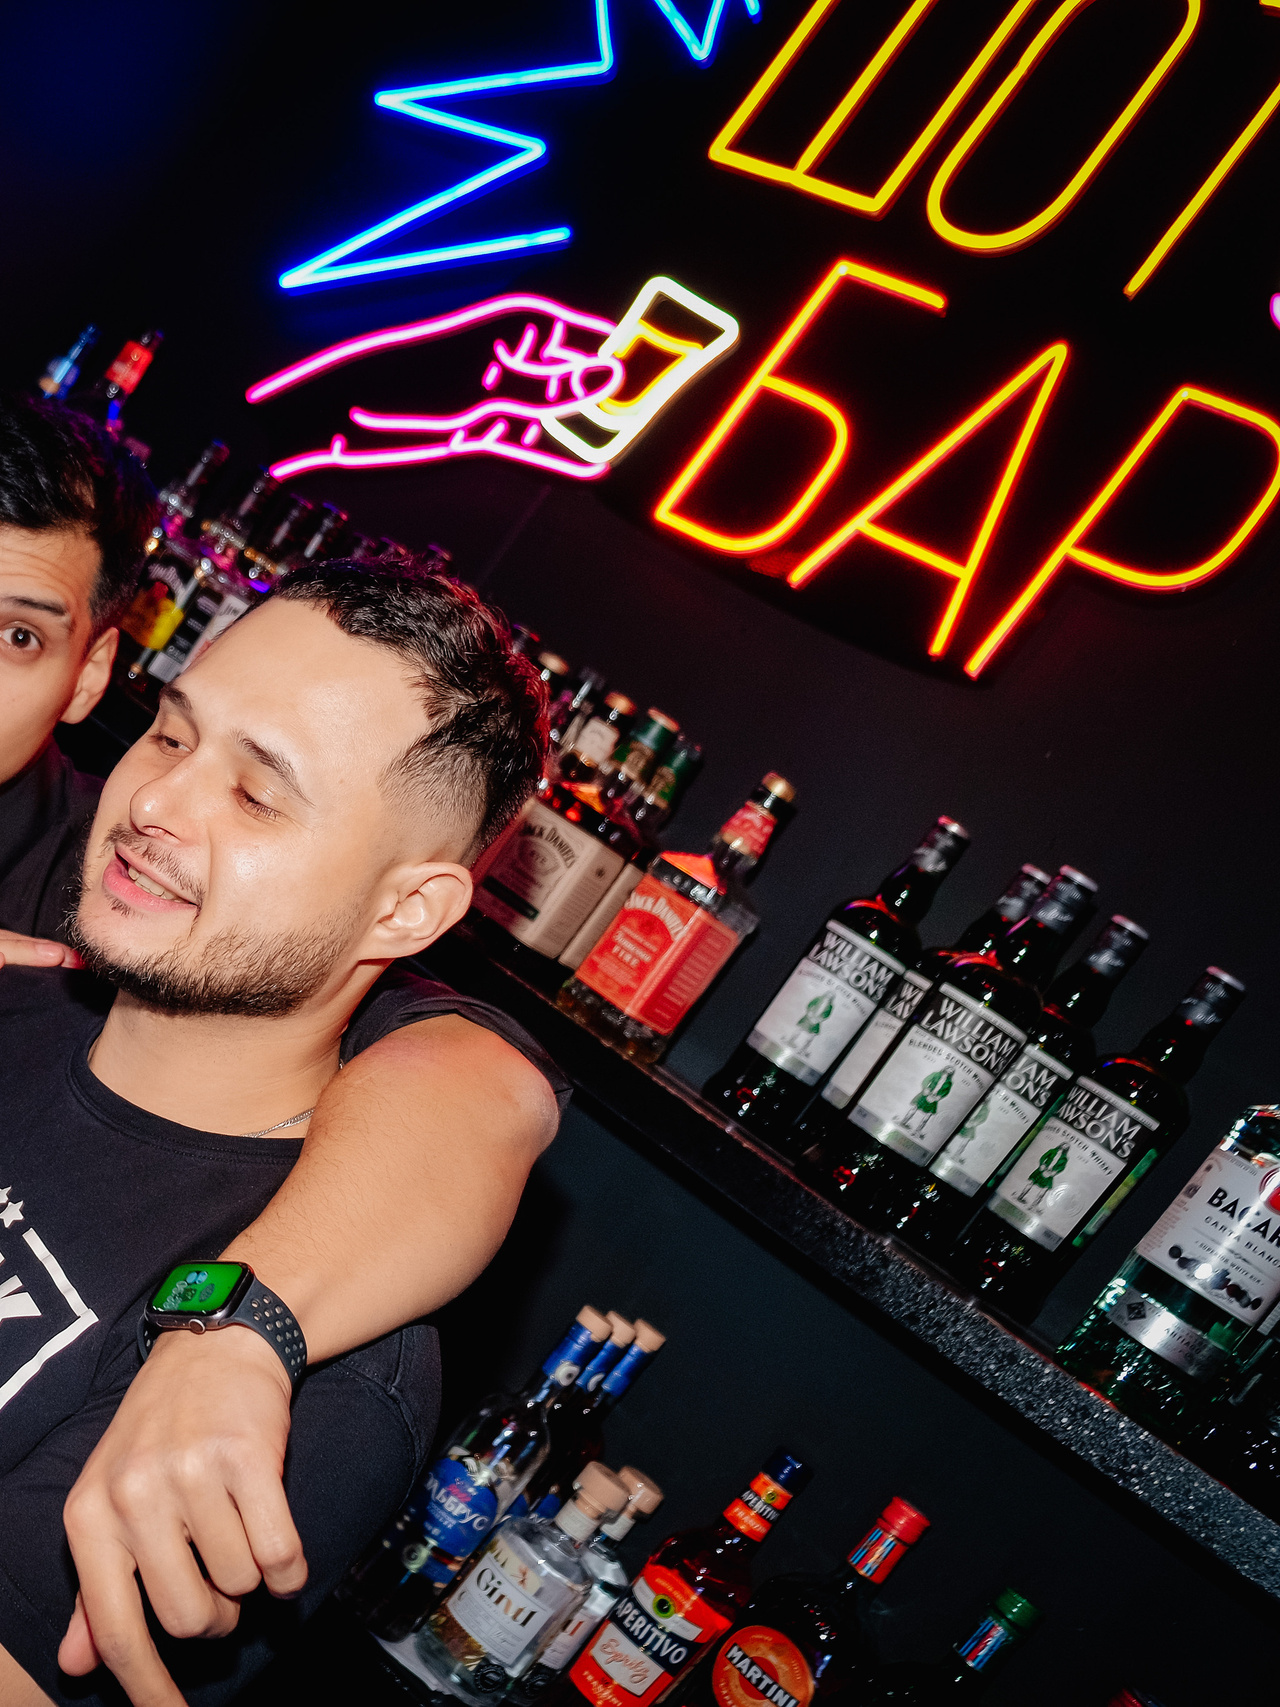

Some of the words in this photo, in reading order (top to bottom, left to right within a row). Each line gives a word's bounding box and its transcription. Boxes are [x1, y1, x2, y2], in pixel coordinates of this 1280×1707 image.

[656, 261, 1280, 677] БАР
[807, 940, 887, 1002] LAWSON'S
[822, 930, 895, 986] WILLIAM
[918, 1008, 1007, 1075] LAWSON'S
[939, 996, 1018, 1059] WILLIAM
[1055, 1101, 1136, 1161] AWSON'S
[1066, 1084, 1142, 1140] WILLIAM
[1060, 1128, 1089, 1151] SCOTCH
[1090, 1148, 1113, 1176] WHISKY
[740, 1488, 780, 1524] APERITIV
[612, 1596, 689, 1666] APERITIVO
[725, 1644, 798, 1707] MARTINI
